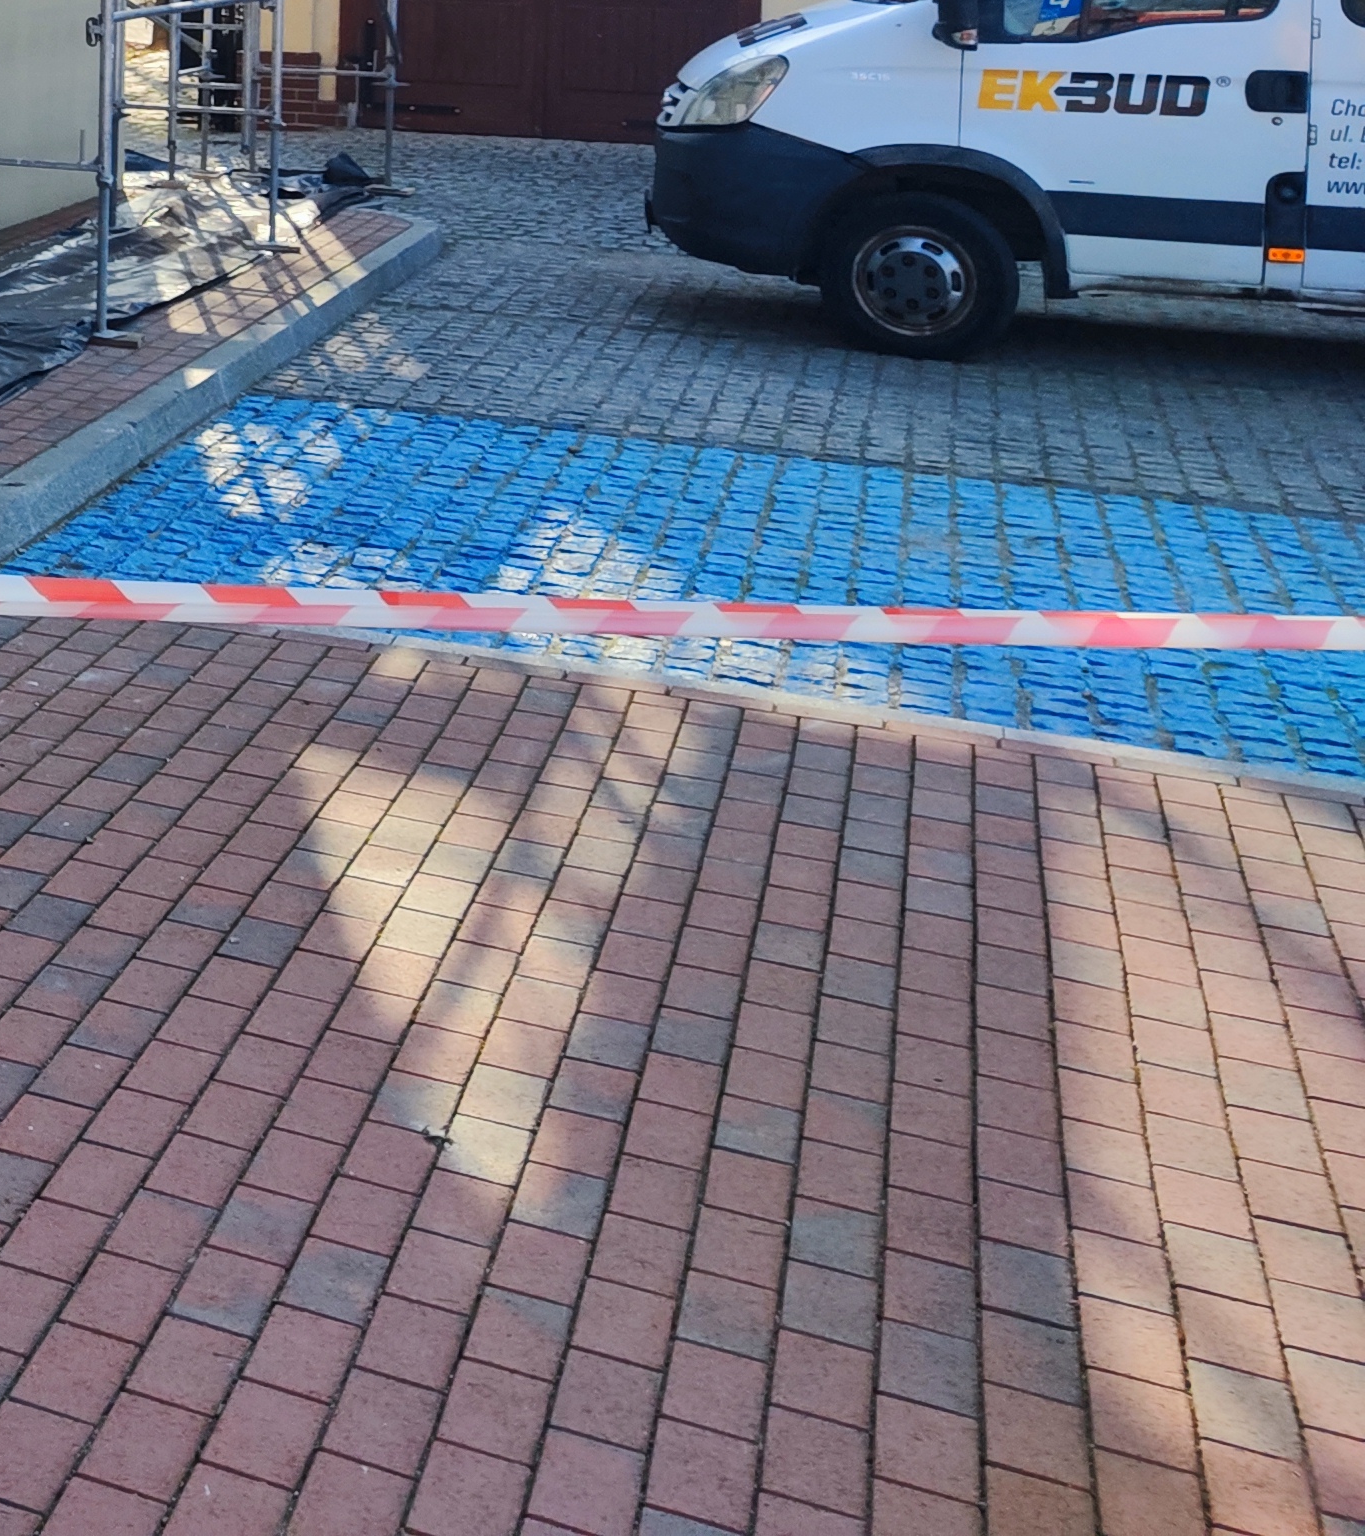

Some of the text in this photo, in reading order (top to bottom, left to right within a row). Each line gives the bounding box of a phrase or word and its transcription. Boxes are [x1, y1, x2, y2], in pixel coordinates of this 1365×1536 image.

[1330, 125, 1353, 143] ul.
[1328, 152, 1362, 170] tel:
[1327, 180, 1365, 195] ww
